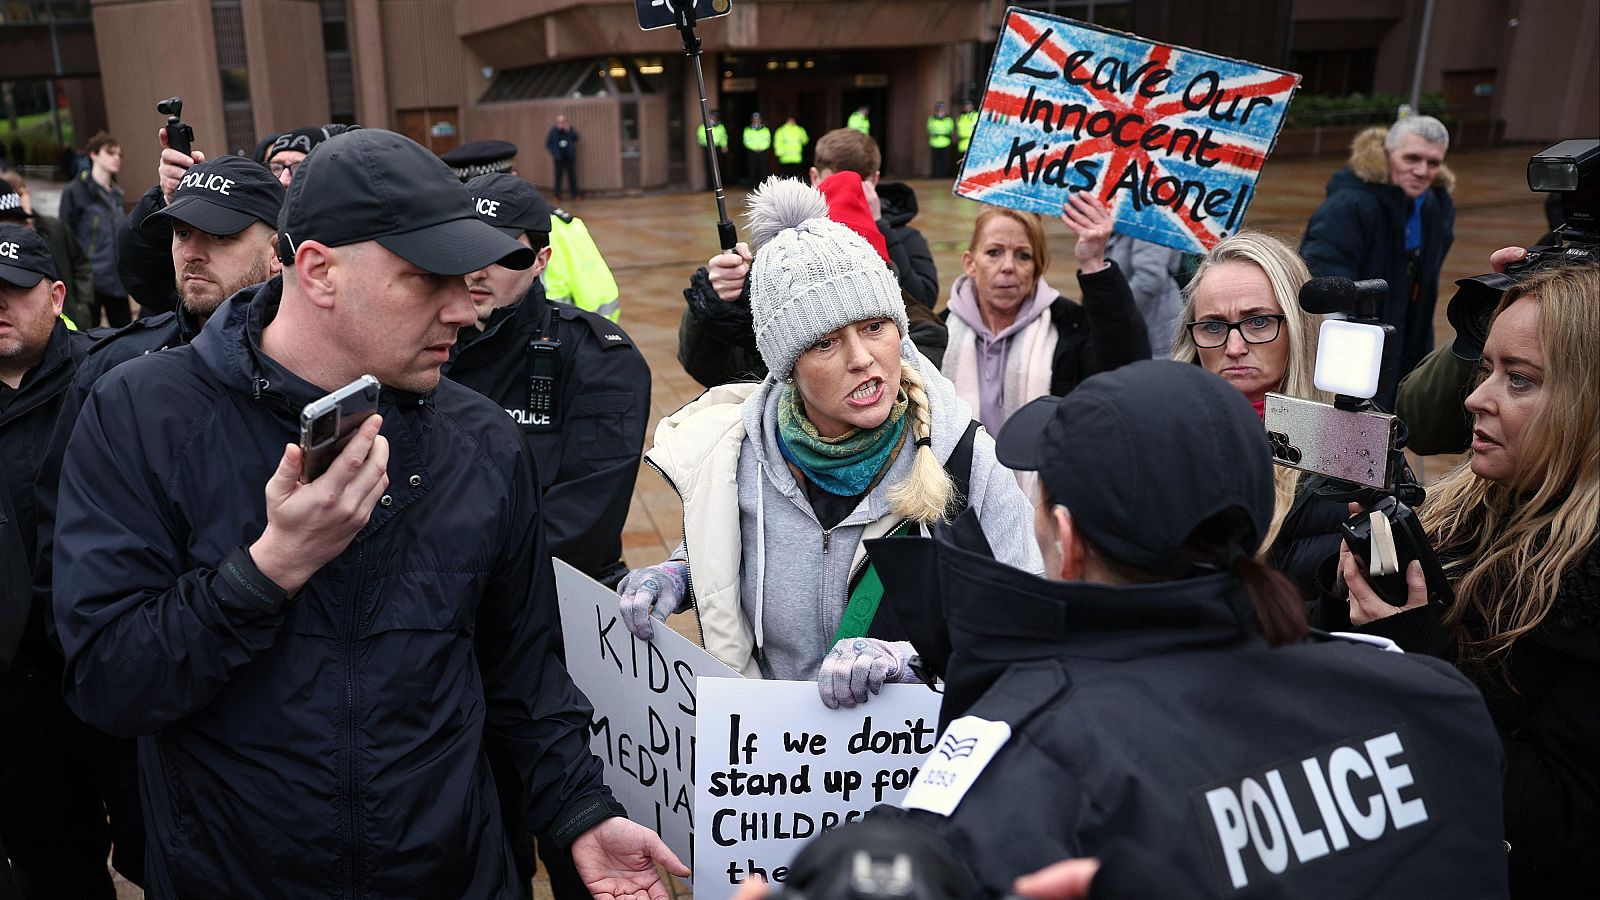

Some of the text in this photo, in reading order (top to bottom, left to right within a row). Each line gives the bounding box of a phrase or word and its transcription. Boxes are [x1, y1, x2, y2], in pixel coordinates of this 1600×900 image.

[1007, 28, 1273, 125] Leave Our
[1019, 85, 1222, 169] Innocent
[177, 172, 236, 196] POLICE
[475, 197, 500, 217] ICE
[1003, 136, 1249, 240] Kids Alone!
[596, 604, 697, 717] KIDS
[729, 713, 935, 765] If we don't
[708, 765, 811, 797] stand
[823, 771, 862, 801] up
[1205, 731, 1429, 889] POLICE
